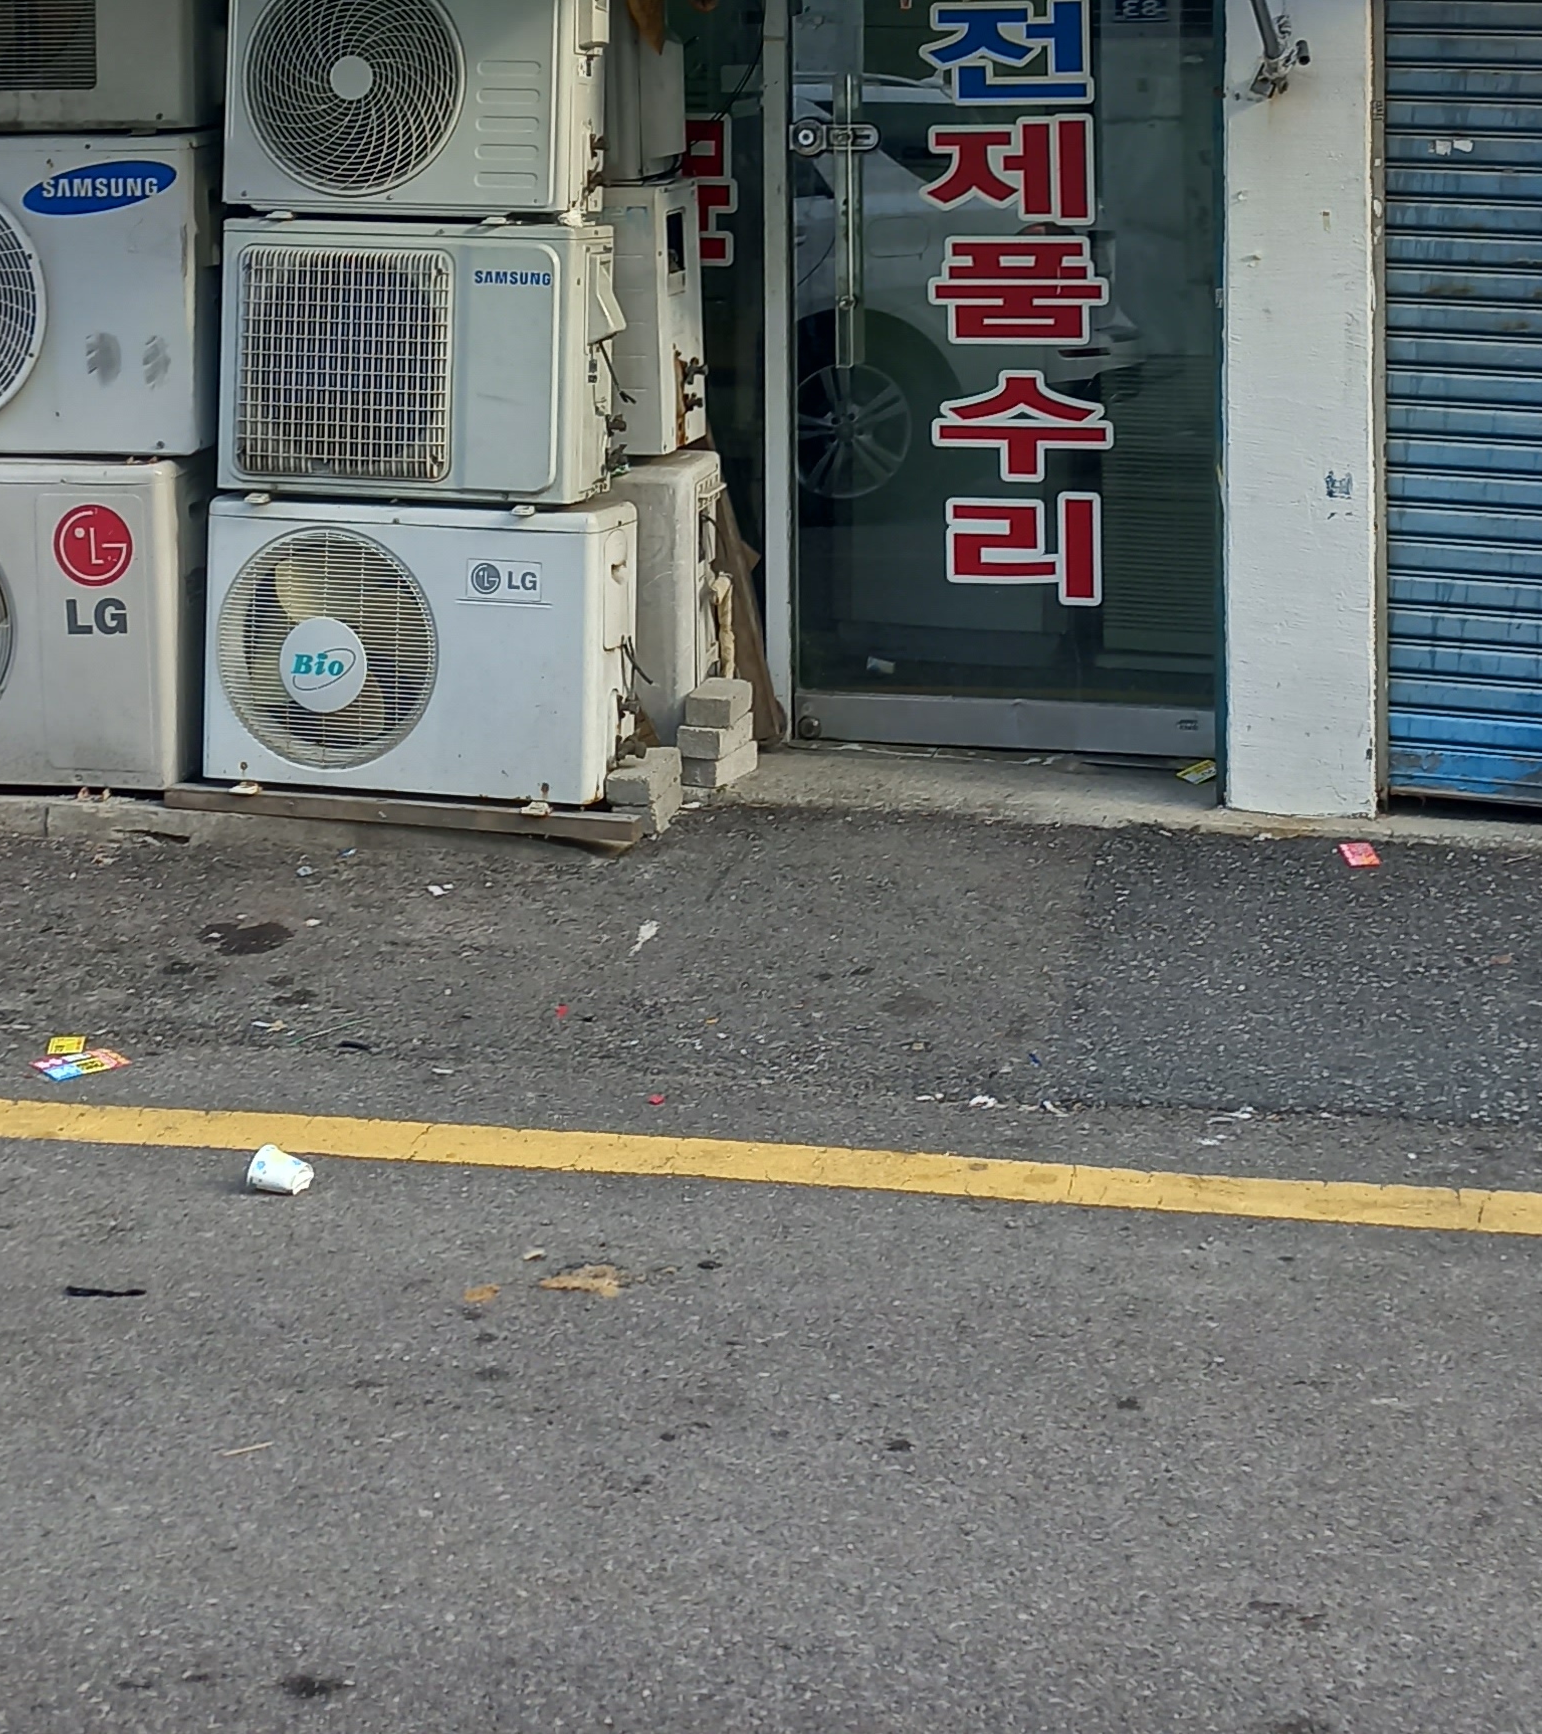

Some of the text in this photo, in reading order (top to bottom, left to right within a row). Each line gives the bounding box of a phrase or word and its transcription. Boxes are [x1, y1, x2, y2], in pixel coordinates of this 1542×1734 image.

[41, 175, 159, 200] SAMSUNG
[474, 269, 552, 287] SAMSUNG
[931, 369, 1114, 606] 수리
[507, 570, 538, 592] LG
[66, 598, 129, 635] LG
[291, 652, 344, 678] Bio
